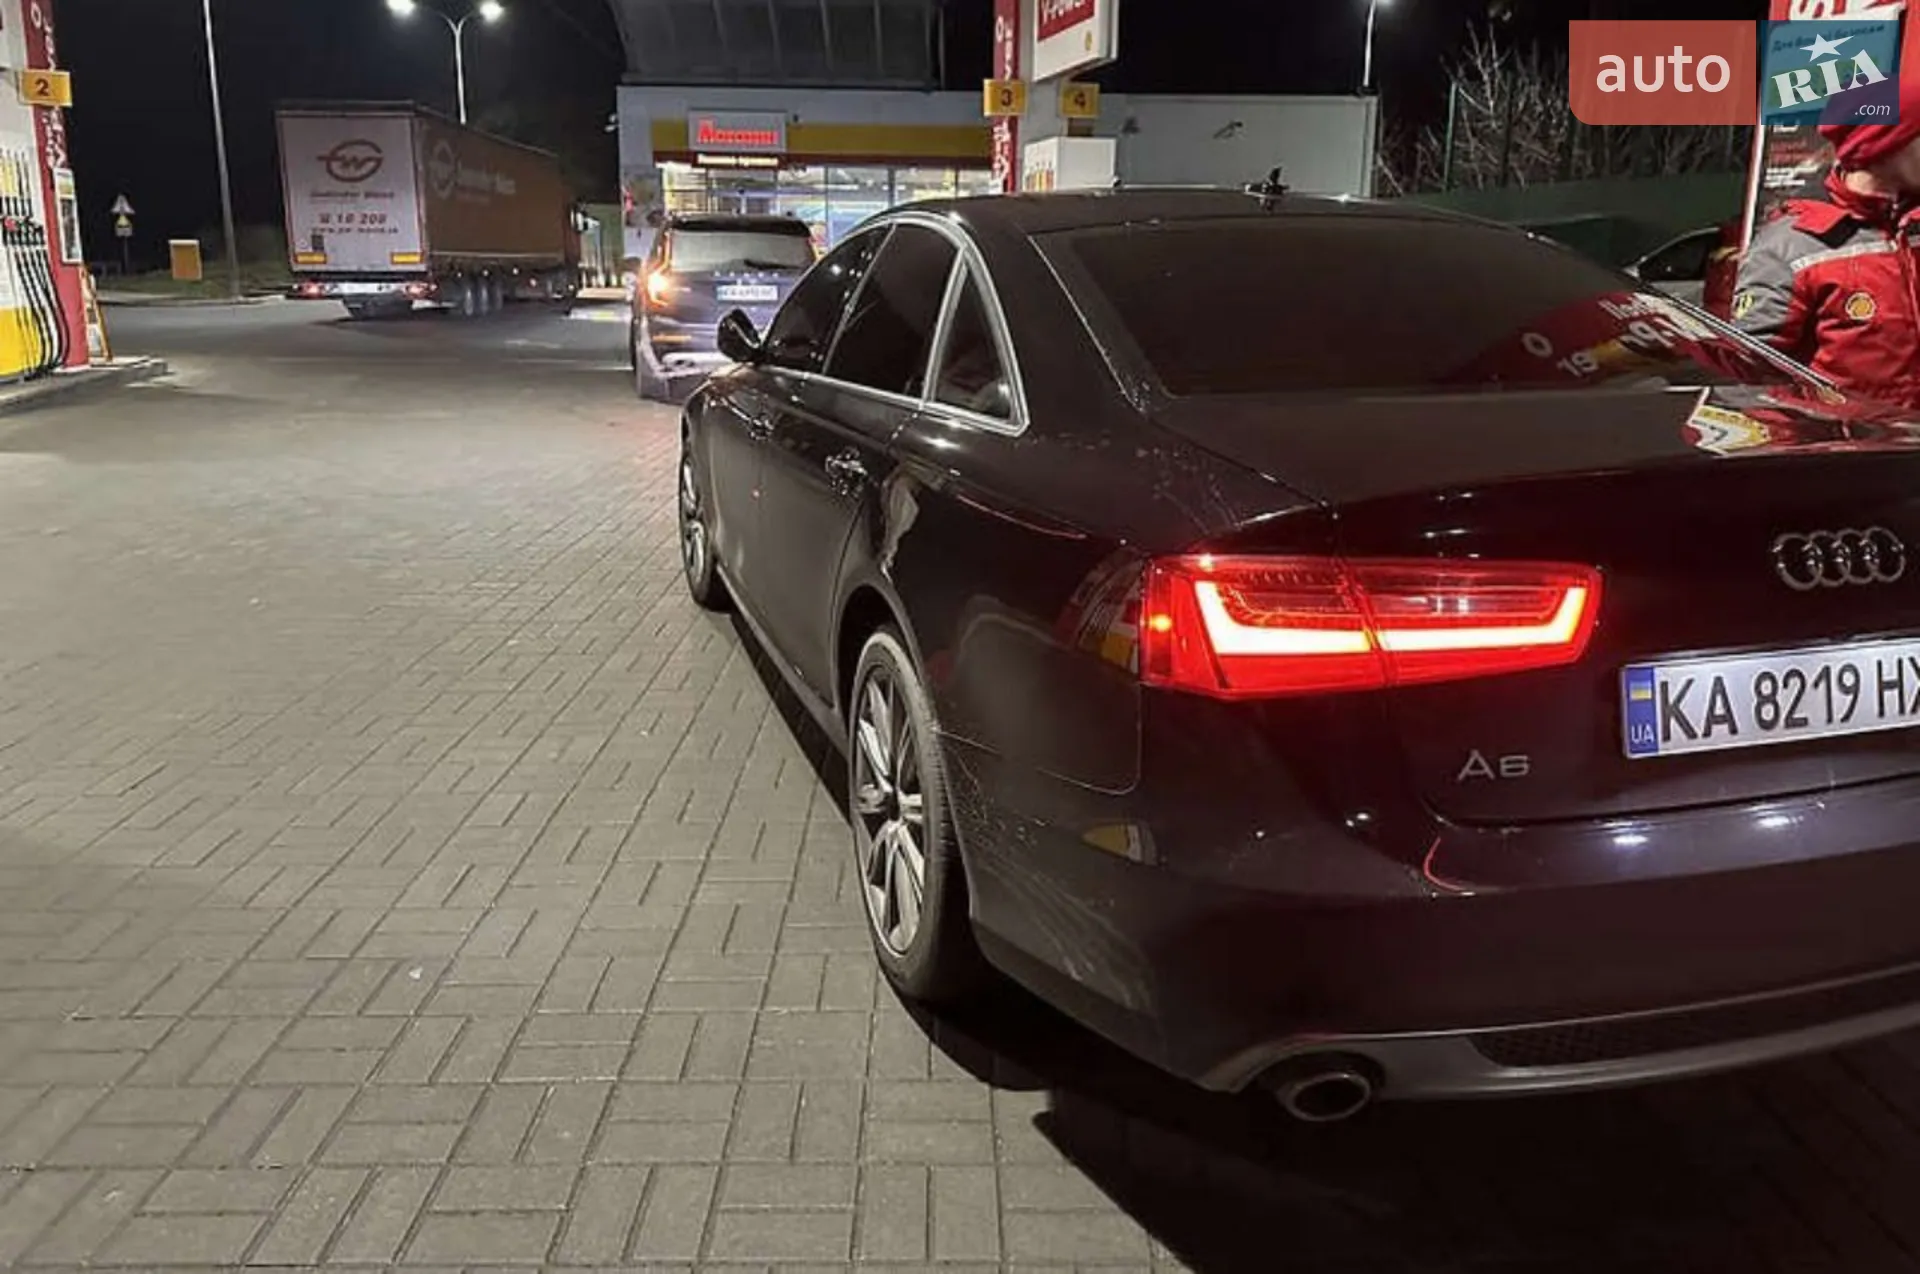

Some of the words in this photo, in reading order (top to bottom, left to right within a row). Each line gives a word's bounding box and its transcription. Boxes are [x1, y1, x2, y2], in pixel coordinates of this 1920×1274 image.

[35, 79, 49, 96] 2
[1001, 89, 1013, 107] 3
[1074, 92, 1086, 108] 4
[1660, 676, 1739, 742] KA
[1753, 663, 1861, 731] 8219
[1631, 725, 1655, 744] UA
[1458, 749, 1529, 780] A6
